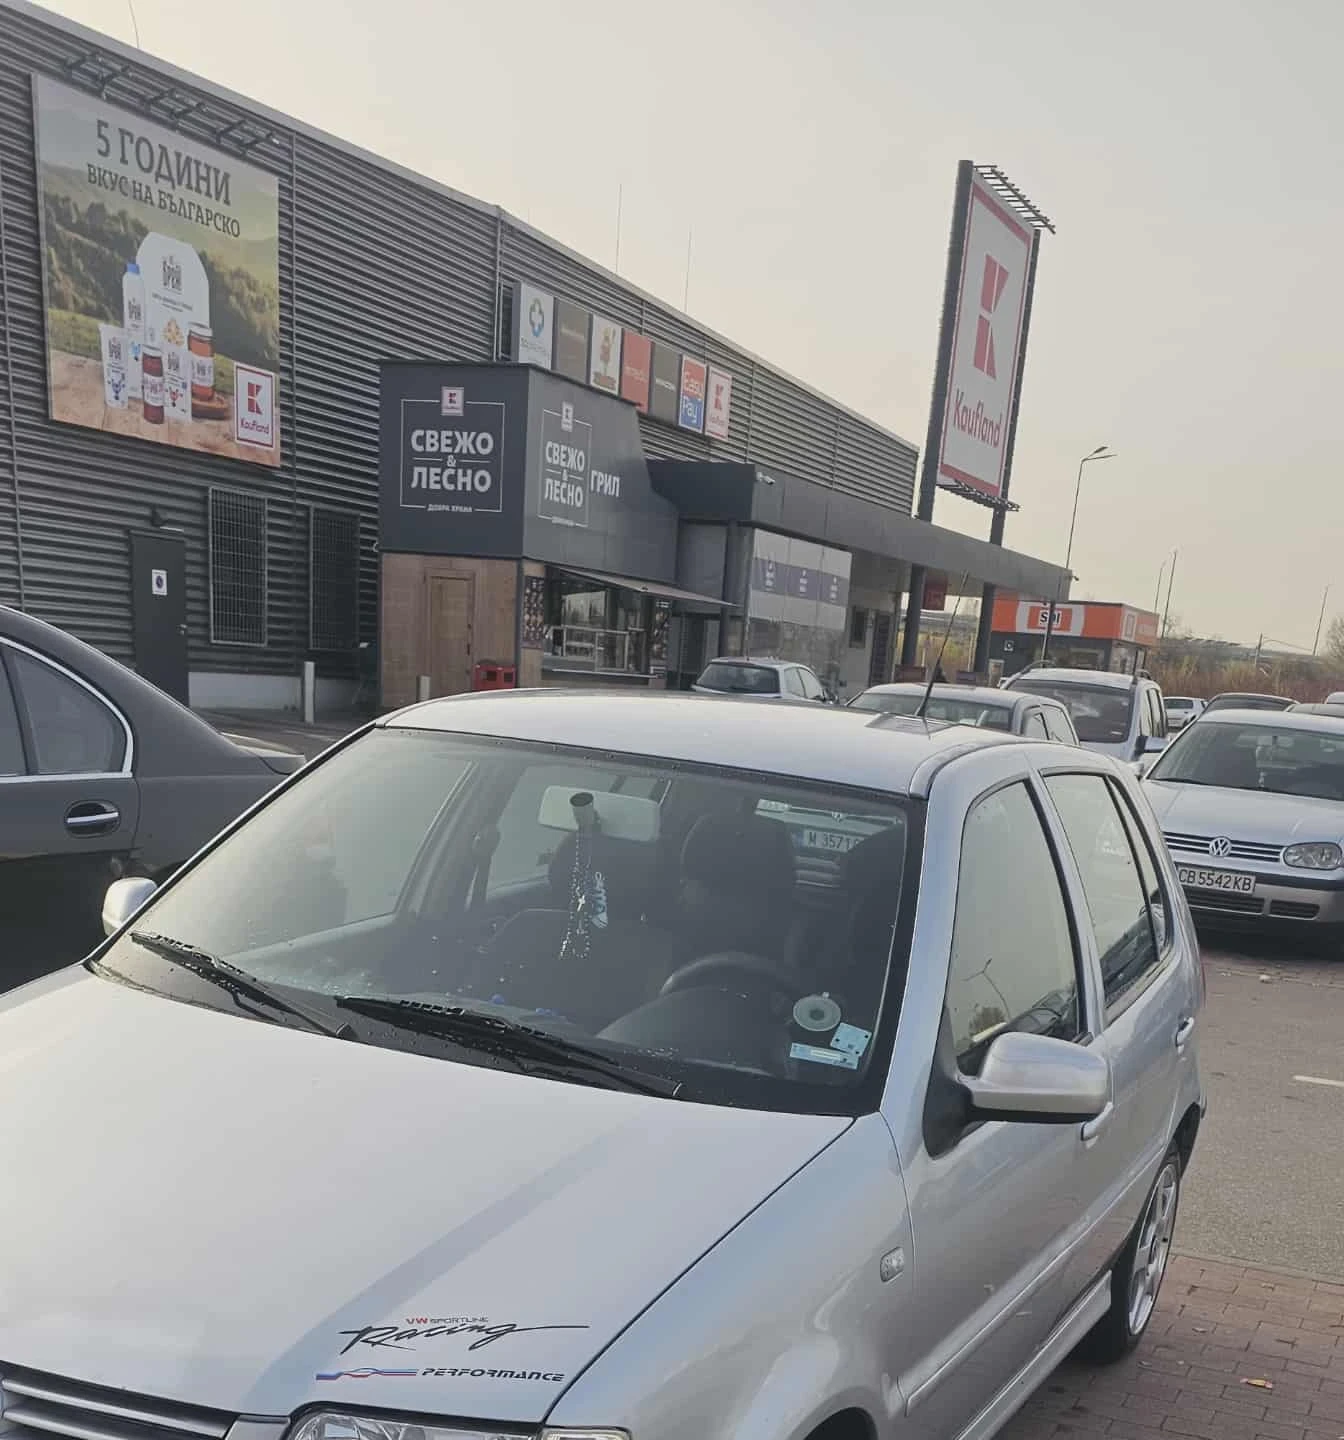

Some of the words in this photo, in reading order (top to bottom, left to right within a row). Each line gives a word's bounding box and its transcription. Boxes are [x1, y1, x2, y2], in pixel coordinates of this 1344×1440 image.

[97, 119, 110, 157] 5
[118, 128, 231, 206] ГОДИНИ
[87, 162, 128, 197] ВКУС
[132, 179, 155, 207] НА
[158, 188, 241, 238] БЪЛГАРСКО
[682, 396, 699, 423] Pay
[953, 388, 1003, 448] Kaufland
[411, 429, 494, 455] СВЕЖО
[446, 455, 457, 467] &
[545, 441, 586, 472] СВЕЖО
[410, 466, 492, 492] ЛЕСНО
[544, 478, 584, 507] ЛЕСНО
[591, 470, 621, 497] ГРИЛ
[1178, 868, 1196, 884] CB
[1199, 872, 1231, 889] 5542
[1233, 876, 1252, 892] KB
[339, 1323, 590, 1355] Racing
[422, 1367, 566, 1382] PERFORMANCE
